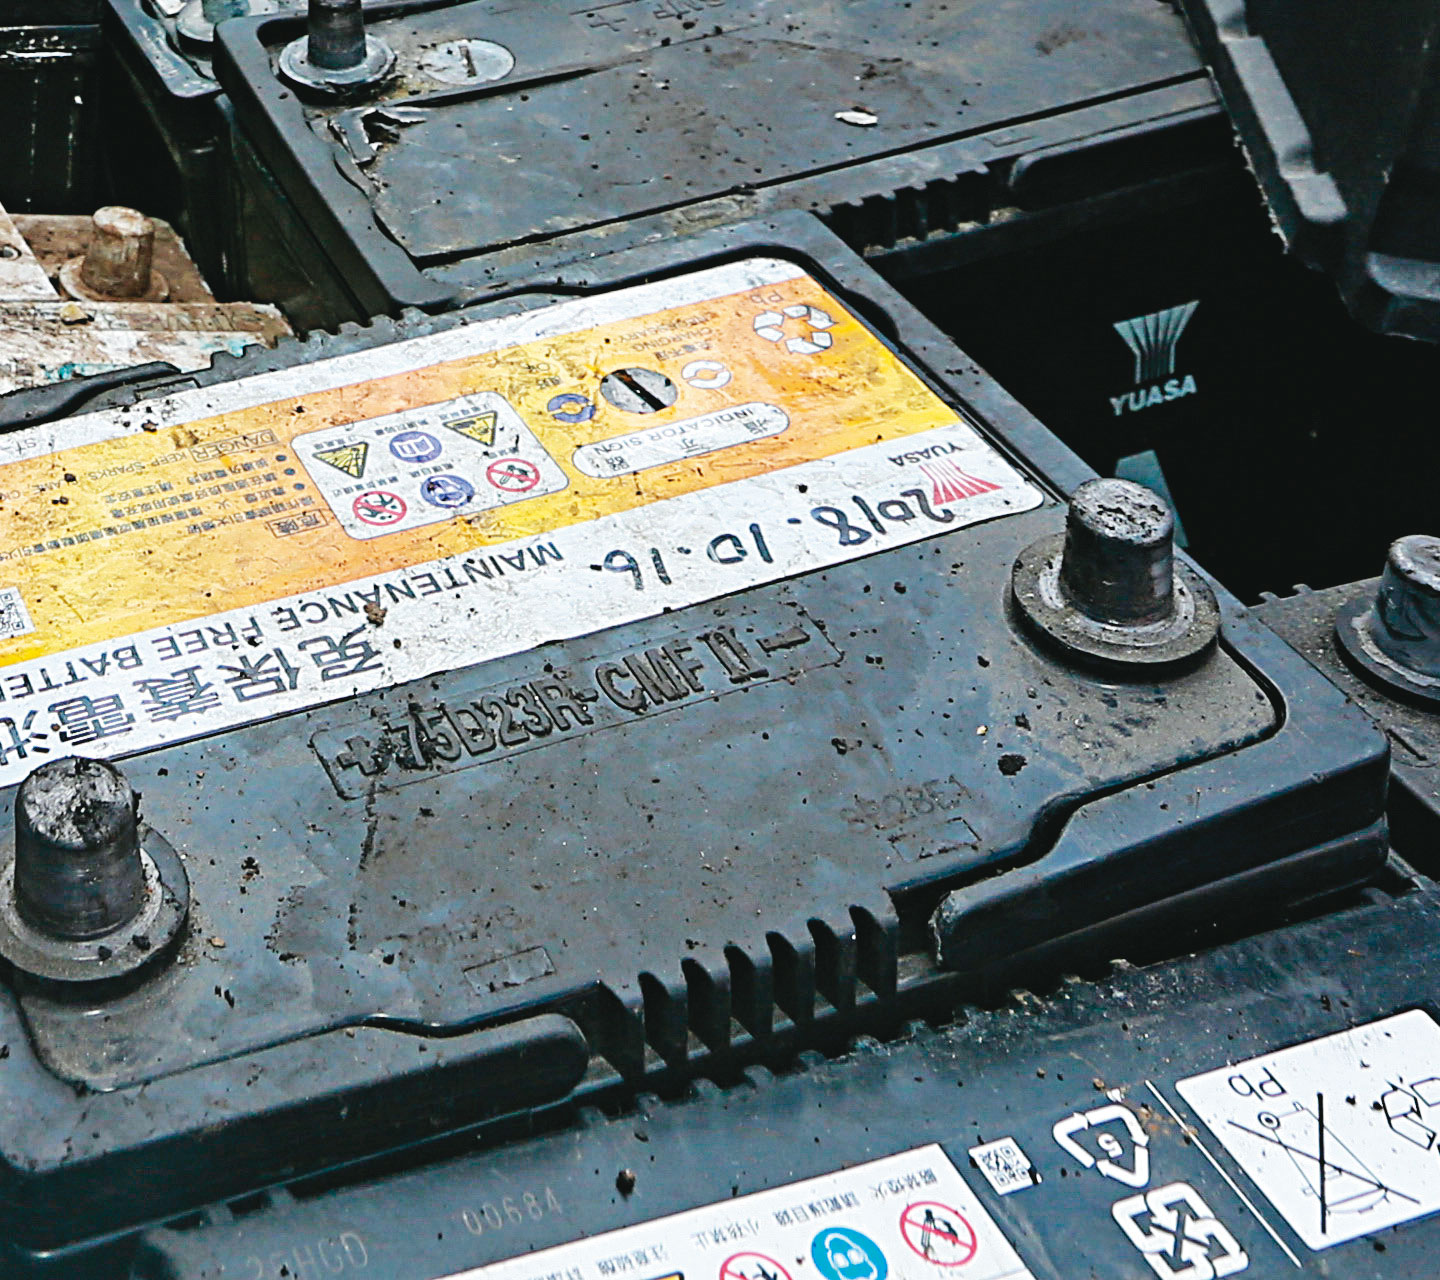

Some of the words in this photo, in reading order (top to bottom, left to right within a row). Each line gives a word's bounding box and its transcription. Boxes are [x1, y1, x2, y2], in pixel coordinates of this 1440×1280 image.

[1110, 375, 1197, 416] YUASA
[648, 408, 755, 443] INDICATOR
[195, 431, 278, 461] DANGER
[593, 432, 647, 457] SIGN
[889, 441, 965, 468] YUASA
[277, 515, 323, 536] 危險
[270, 542, 564, 630] MAINTENANCE
[159, 613, 265, 664] FREE
[1227, 1069, 1290, 1099] Pb
[460, 1187, 564, 1237] 00684
